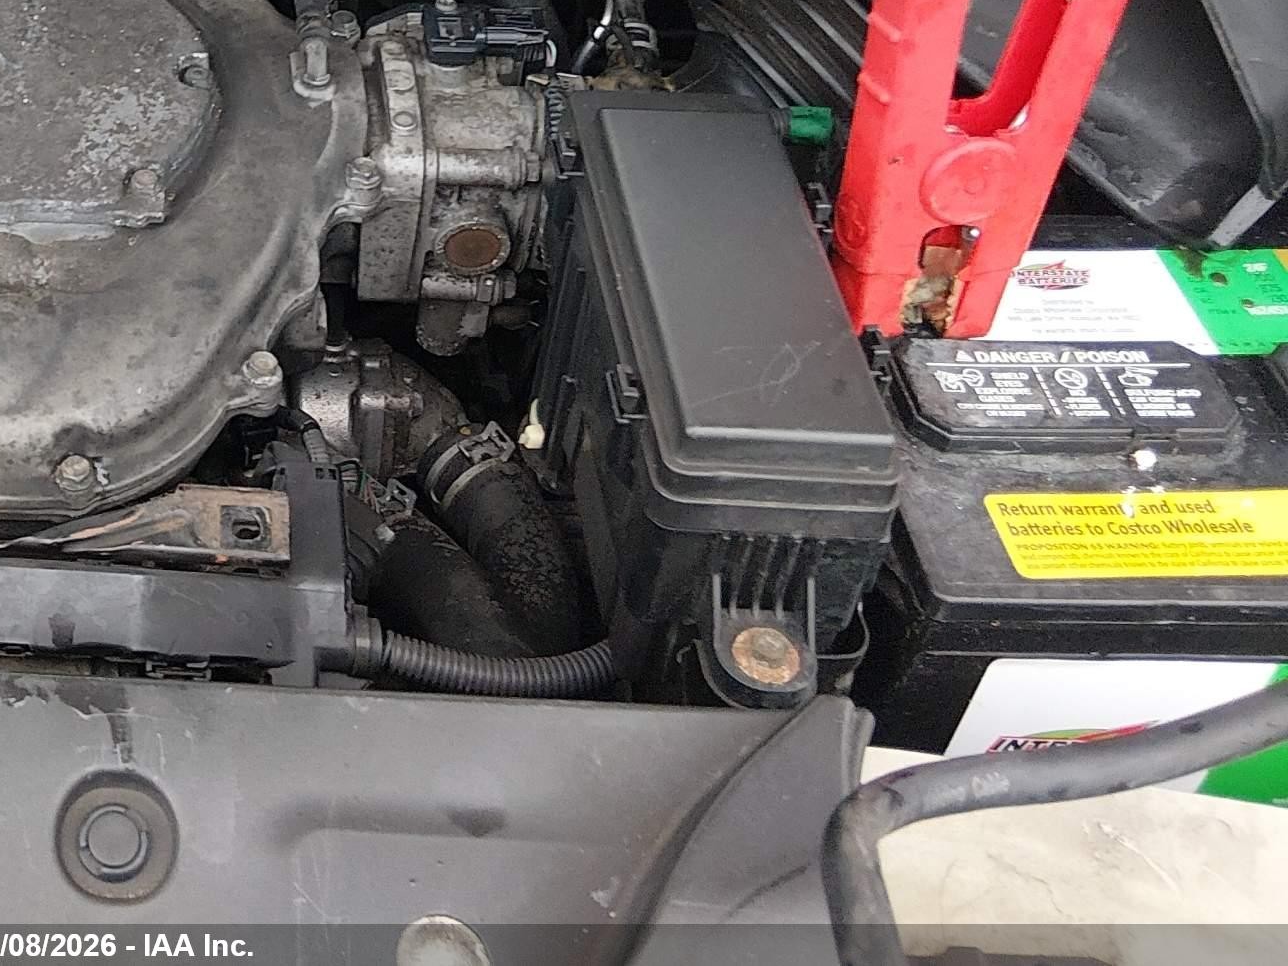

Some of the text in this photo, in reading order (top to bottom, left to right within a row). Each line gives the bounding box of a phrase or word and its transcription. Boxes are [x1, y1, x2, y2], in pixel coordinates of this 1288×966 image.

[1012, 269, 1090, 277] INTERSTATE
[1017, 276, 1090, 286] BATTERIES
[973, 351, 1056, 363] DANGER
[1074, 351, 1150, 363] POISON
[998, 502, 1057, 517] Return
[1139, 500, 1171, 515] and
[1175, 500, 1216, 514] used
[1007, 518, 1254, 536] batteries to Costco Wholesale
